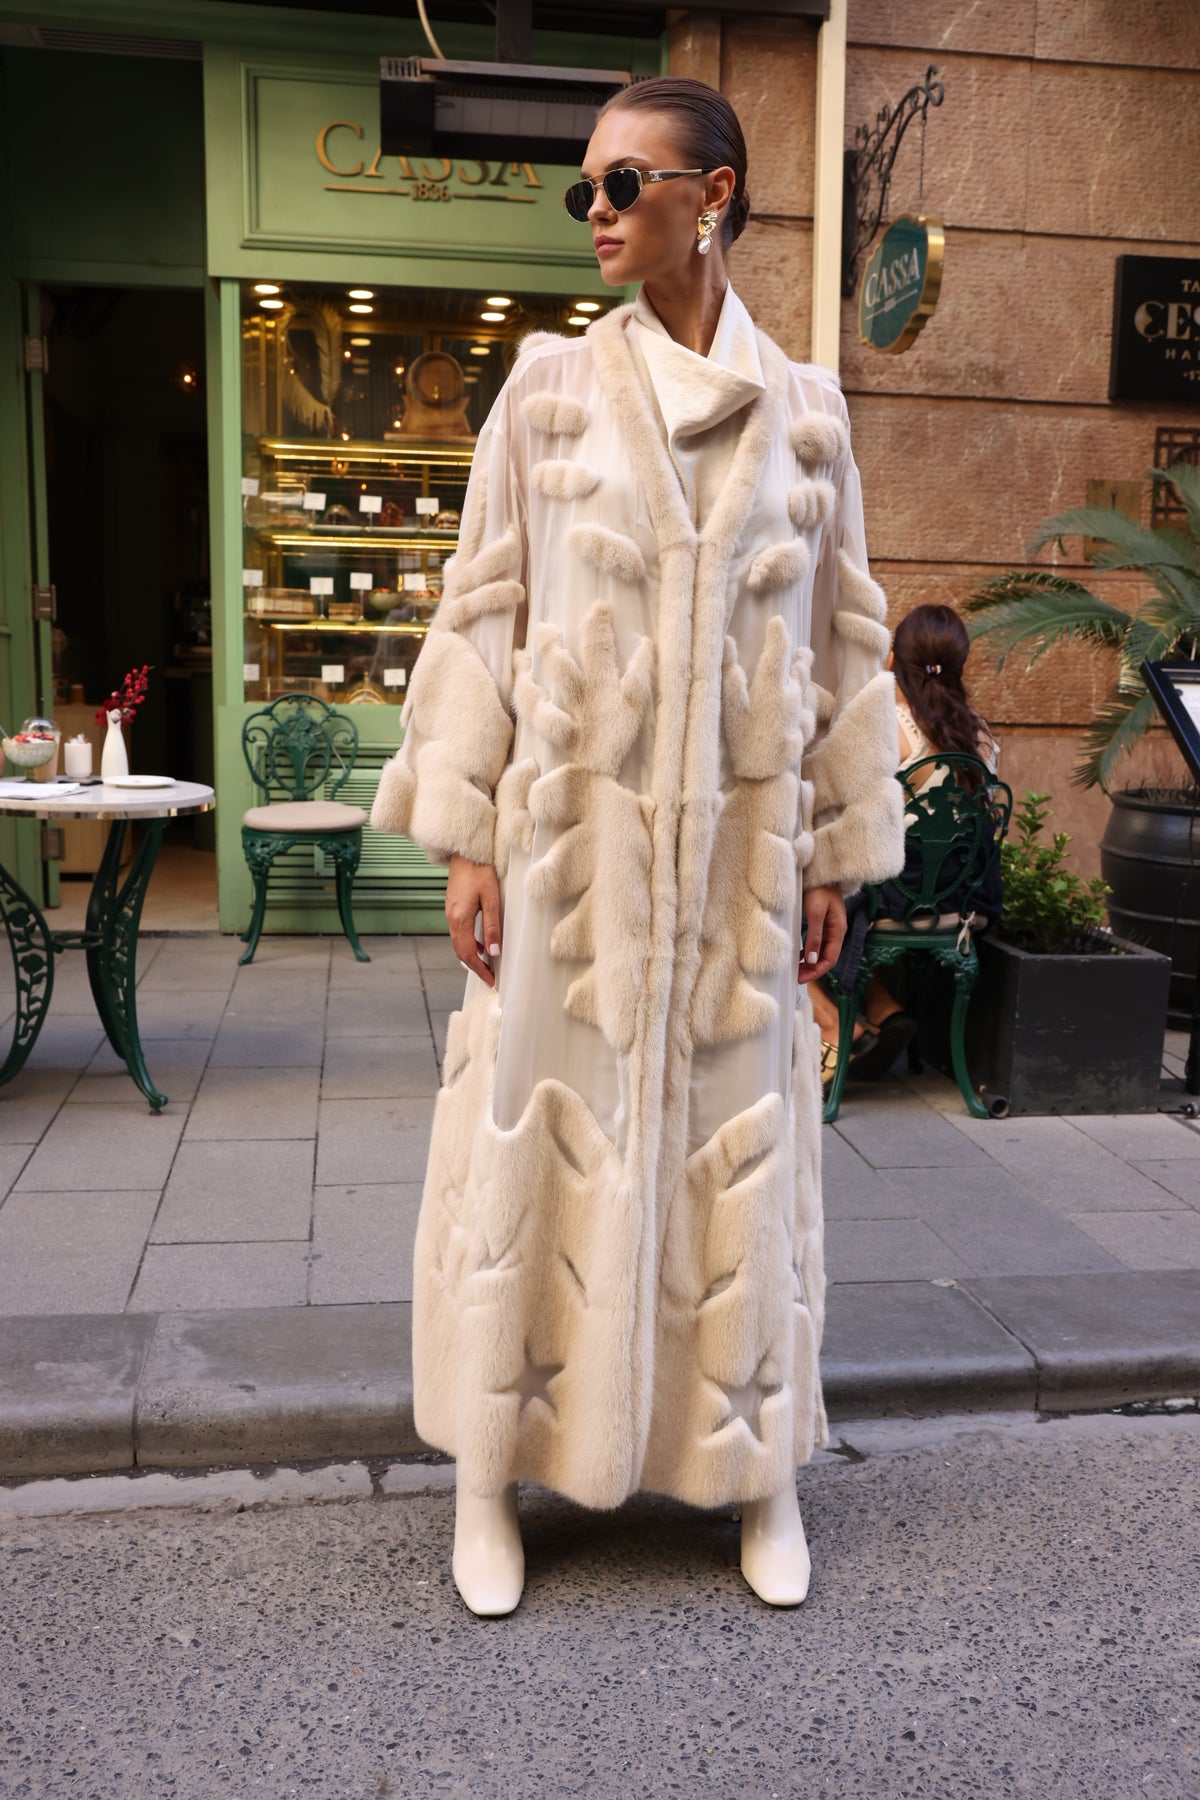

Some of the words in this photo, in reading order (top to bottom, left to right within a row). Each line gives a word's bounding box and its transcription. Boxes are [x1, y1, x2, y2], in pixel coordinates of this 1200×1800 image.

[412, 183, 450, 201] 1836
[865, 247, 920, 308] CASSA
[1165, 348, 1200, 360] HA
